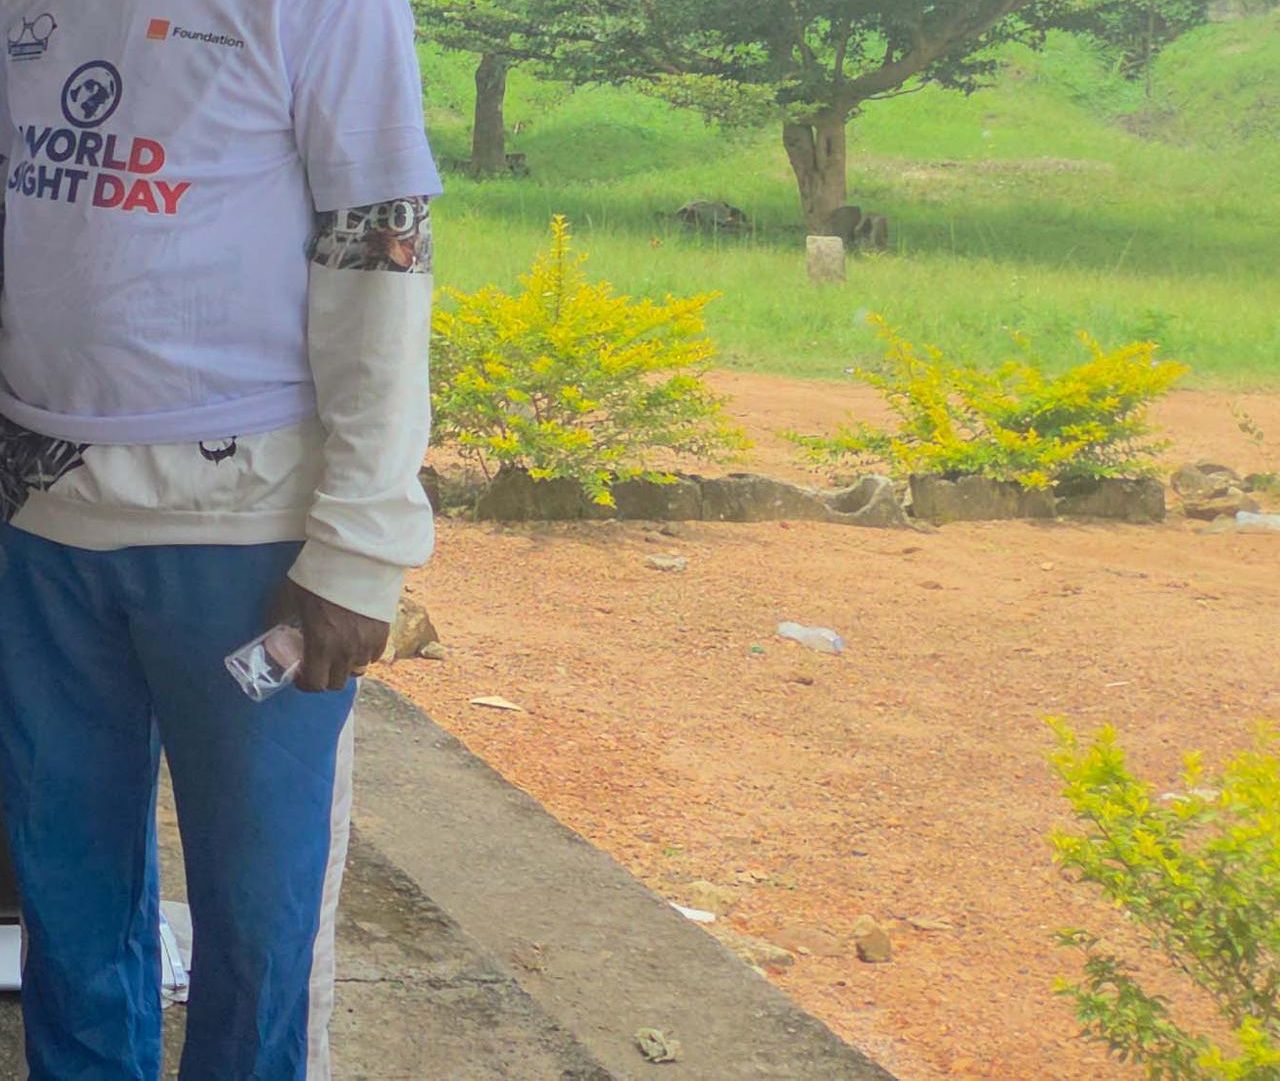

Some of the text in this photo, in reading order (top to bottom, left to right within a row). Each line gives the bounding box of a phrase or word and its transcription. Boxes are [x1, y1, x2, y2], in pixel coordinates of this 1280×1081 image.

[172, 26, 245, 49] Foundation
[18, 124, 166, 175] WORLD
[8, 158, 192, 215] SIGHT DAY
